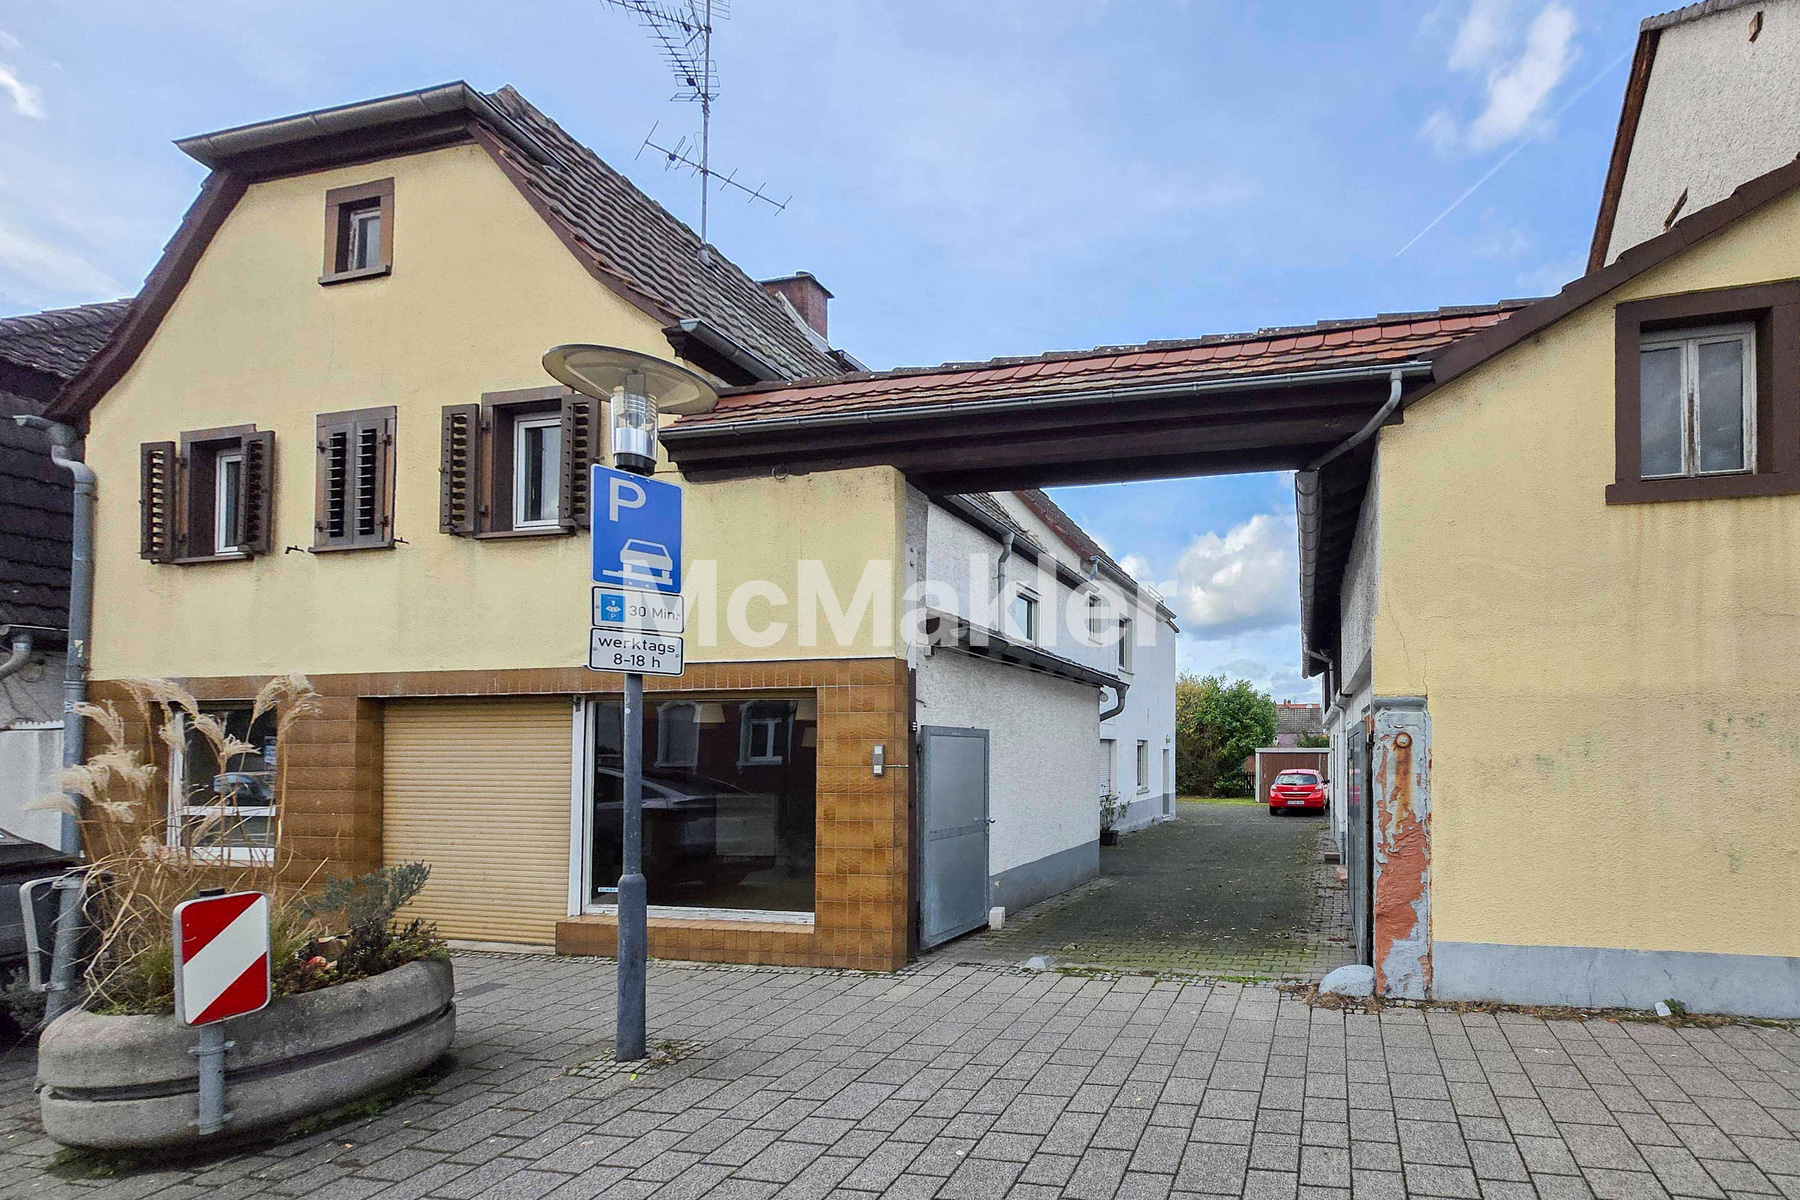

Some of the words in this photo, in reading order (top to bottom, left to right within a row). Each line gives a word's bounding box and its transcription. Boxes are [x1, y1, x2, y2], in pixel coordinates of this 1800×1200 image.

[609, 477, 647, 522] P
[629, 605, 647, 617] 30
[652, 608, 679, 620] Min.
[598, 637, 676, 655] werktags
[613, 653, 646, 667] 8-18
[652, 656, 660, 668] h
